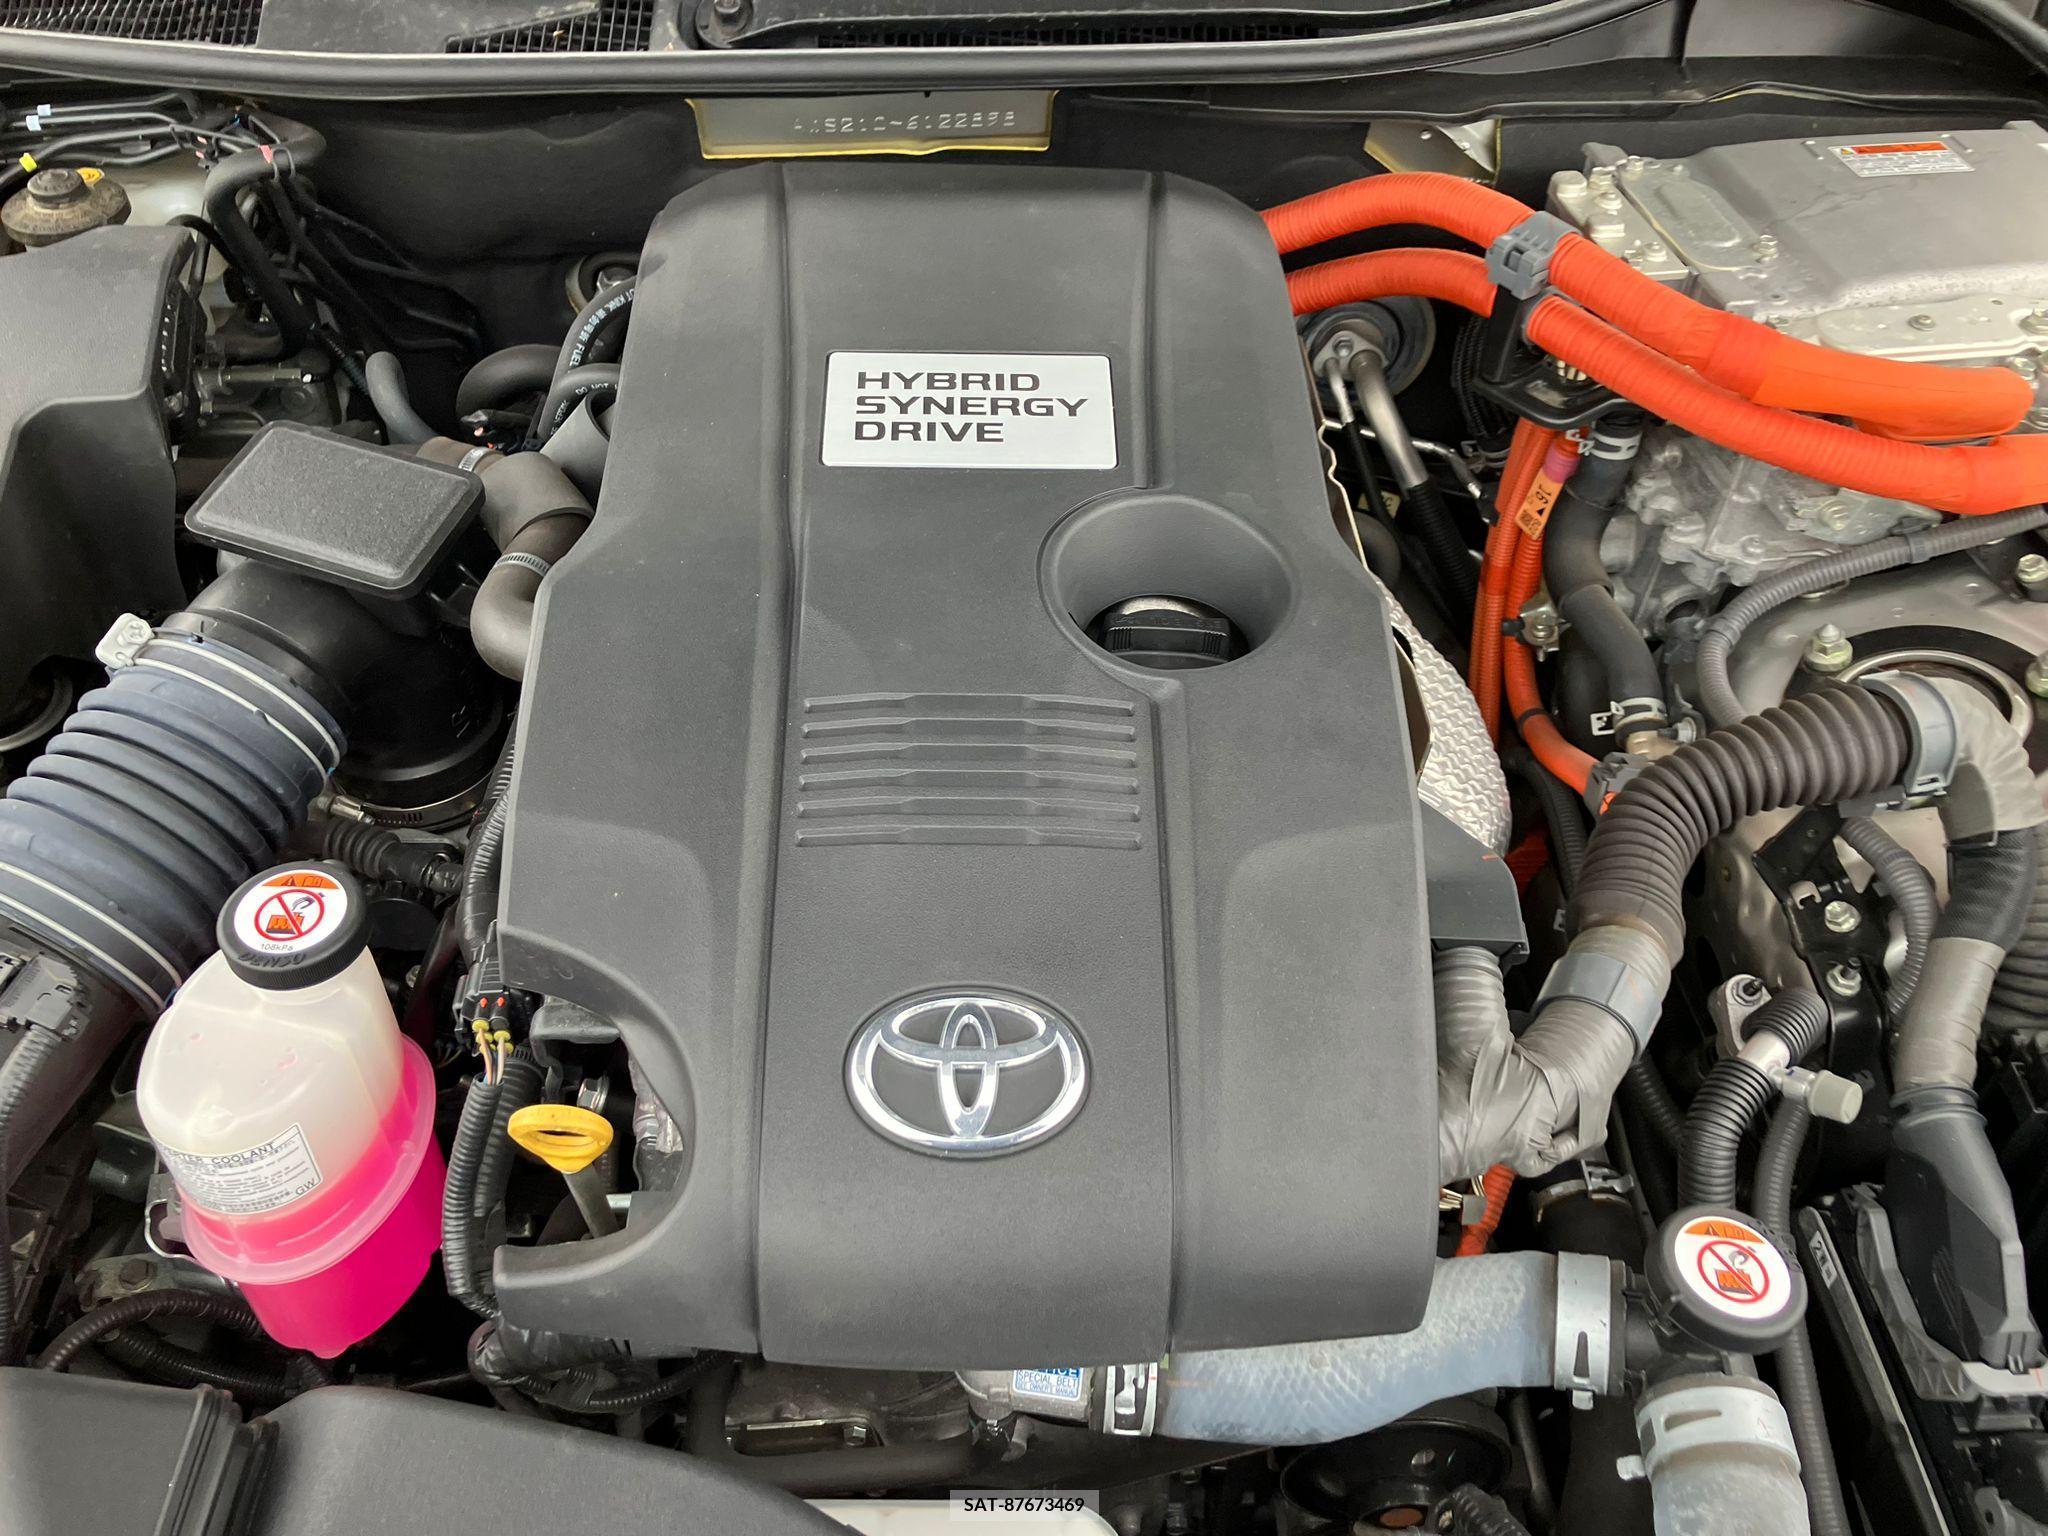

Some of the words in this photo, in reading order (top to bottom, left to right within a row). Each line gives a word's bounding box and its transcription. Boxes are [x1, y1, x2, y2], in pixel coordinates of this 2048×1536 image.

[569, 342, 585, 367] FUEL
[857, 372, 1040, 391] HYBRID
[856, 396, 1088, 417] SYNERGY
[854, 421, 1004, 442] DRIVE
[211, 1141, 276, 1165] COOLANT
[295, 1177, 315, 1196] GW
[1018, 1371, 1051, 1384] SPECIAL
[1057, 1375, 1077, 1388] BELT
